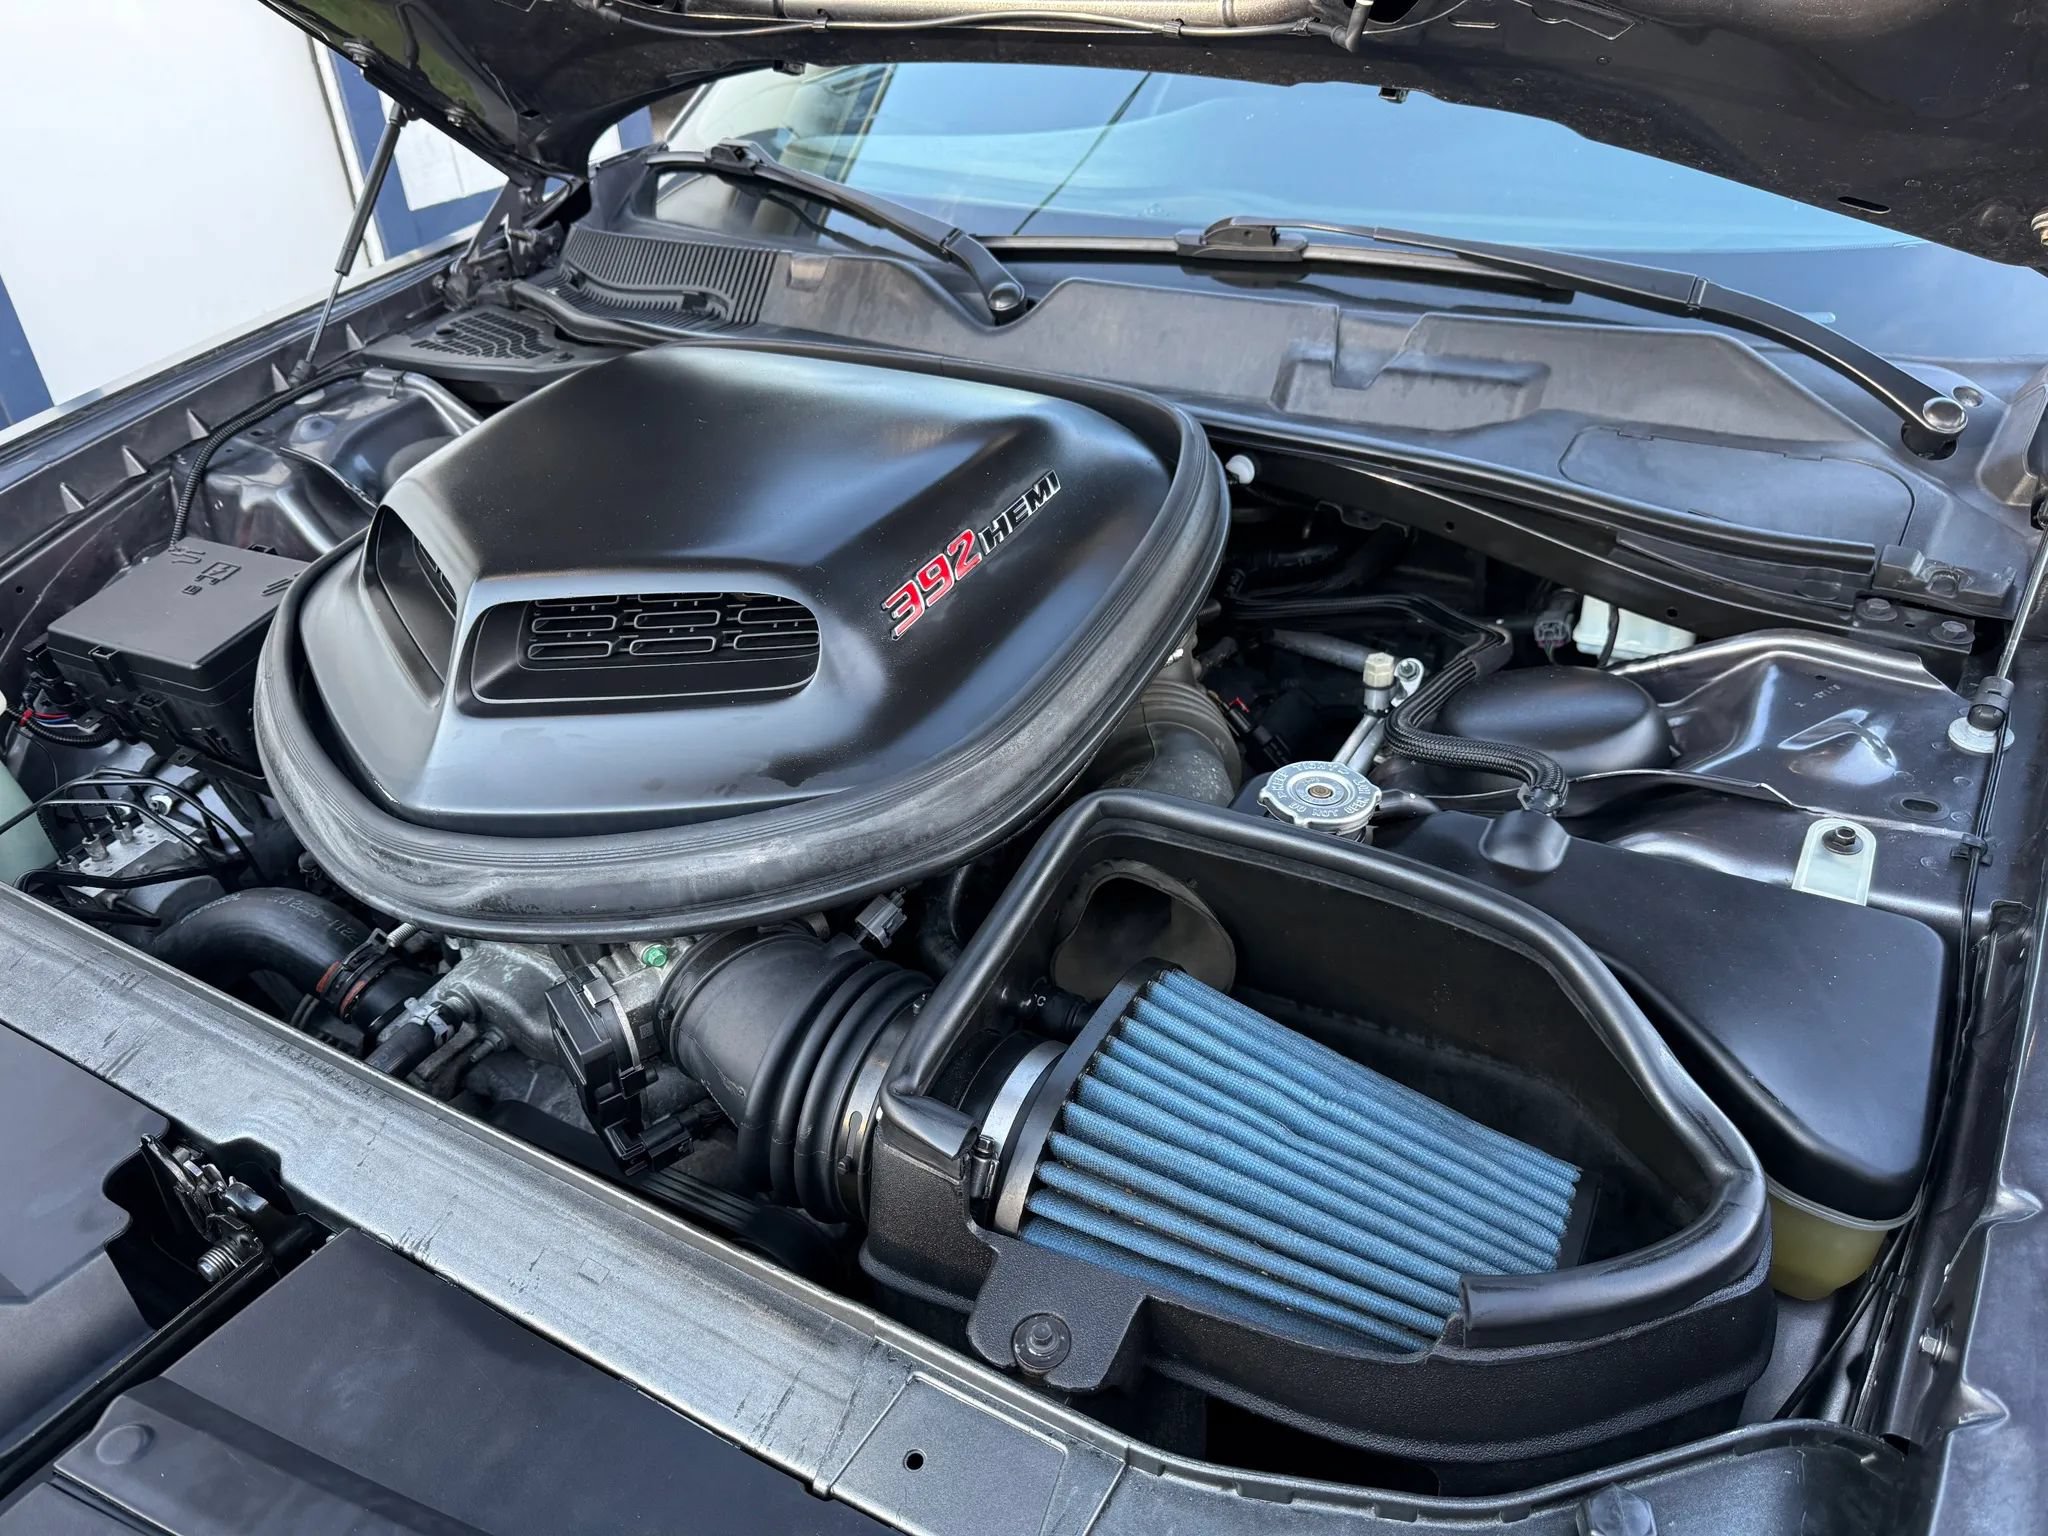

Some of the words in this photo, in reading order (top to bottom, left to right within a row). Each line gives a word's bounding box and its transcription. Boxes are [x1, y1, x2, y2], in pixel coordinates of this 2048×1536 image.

[880, 528, 982, 641] 392
[978, 469, 1061, 555] HEMI
[1312, 808, 1339, 817] NOT
